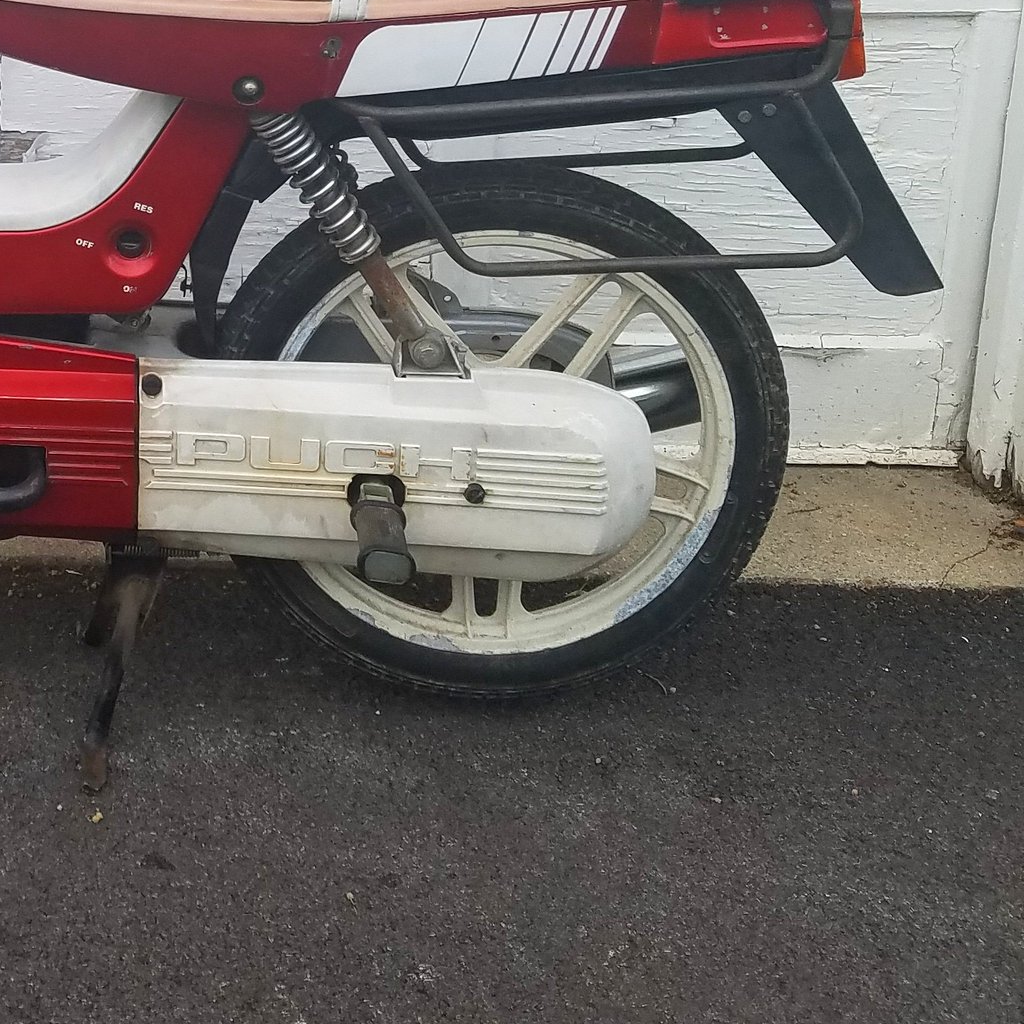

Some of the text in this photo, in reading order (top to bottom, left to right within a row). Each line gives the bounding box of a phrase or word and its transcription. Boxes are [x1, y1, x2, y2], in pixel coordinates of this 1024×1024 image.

[133, 202, 153, 213] RES
[75, 238, 94, 248] OFF
[176, 432, 474, 481] PUCH
